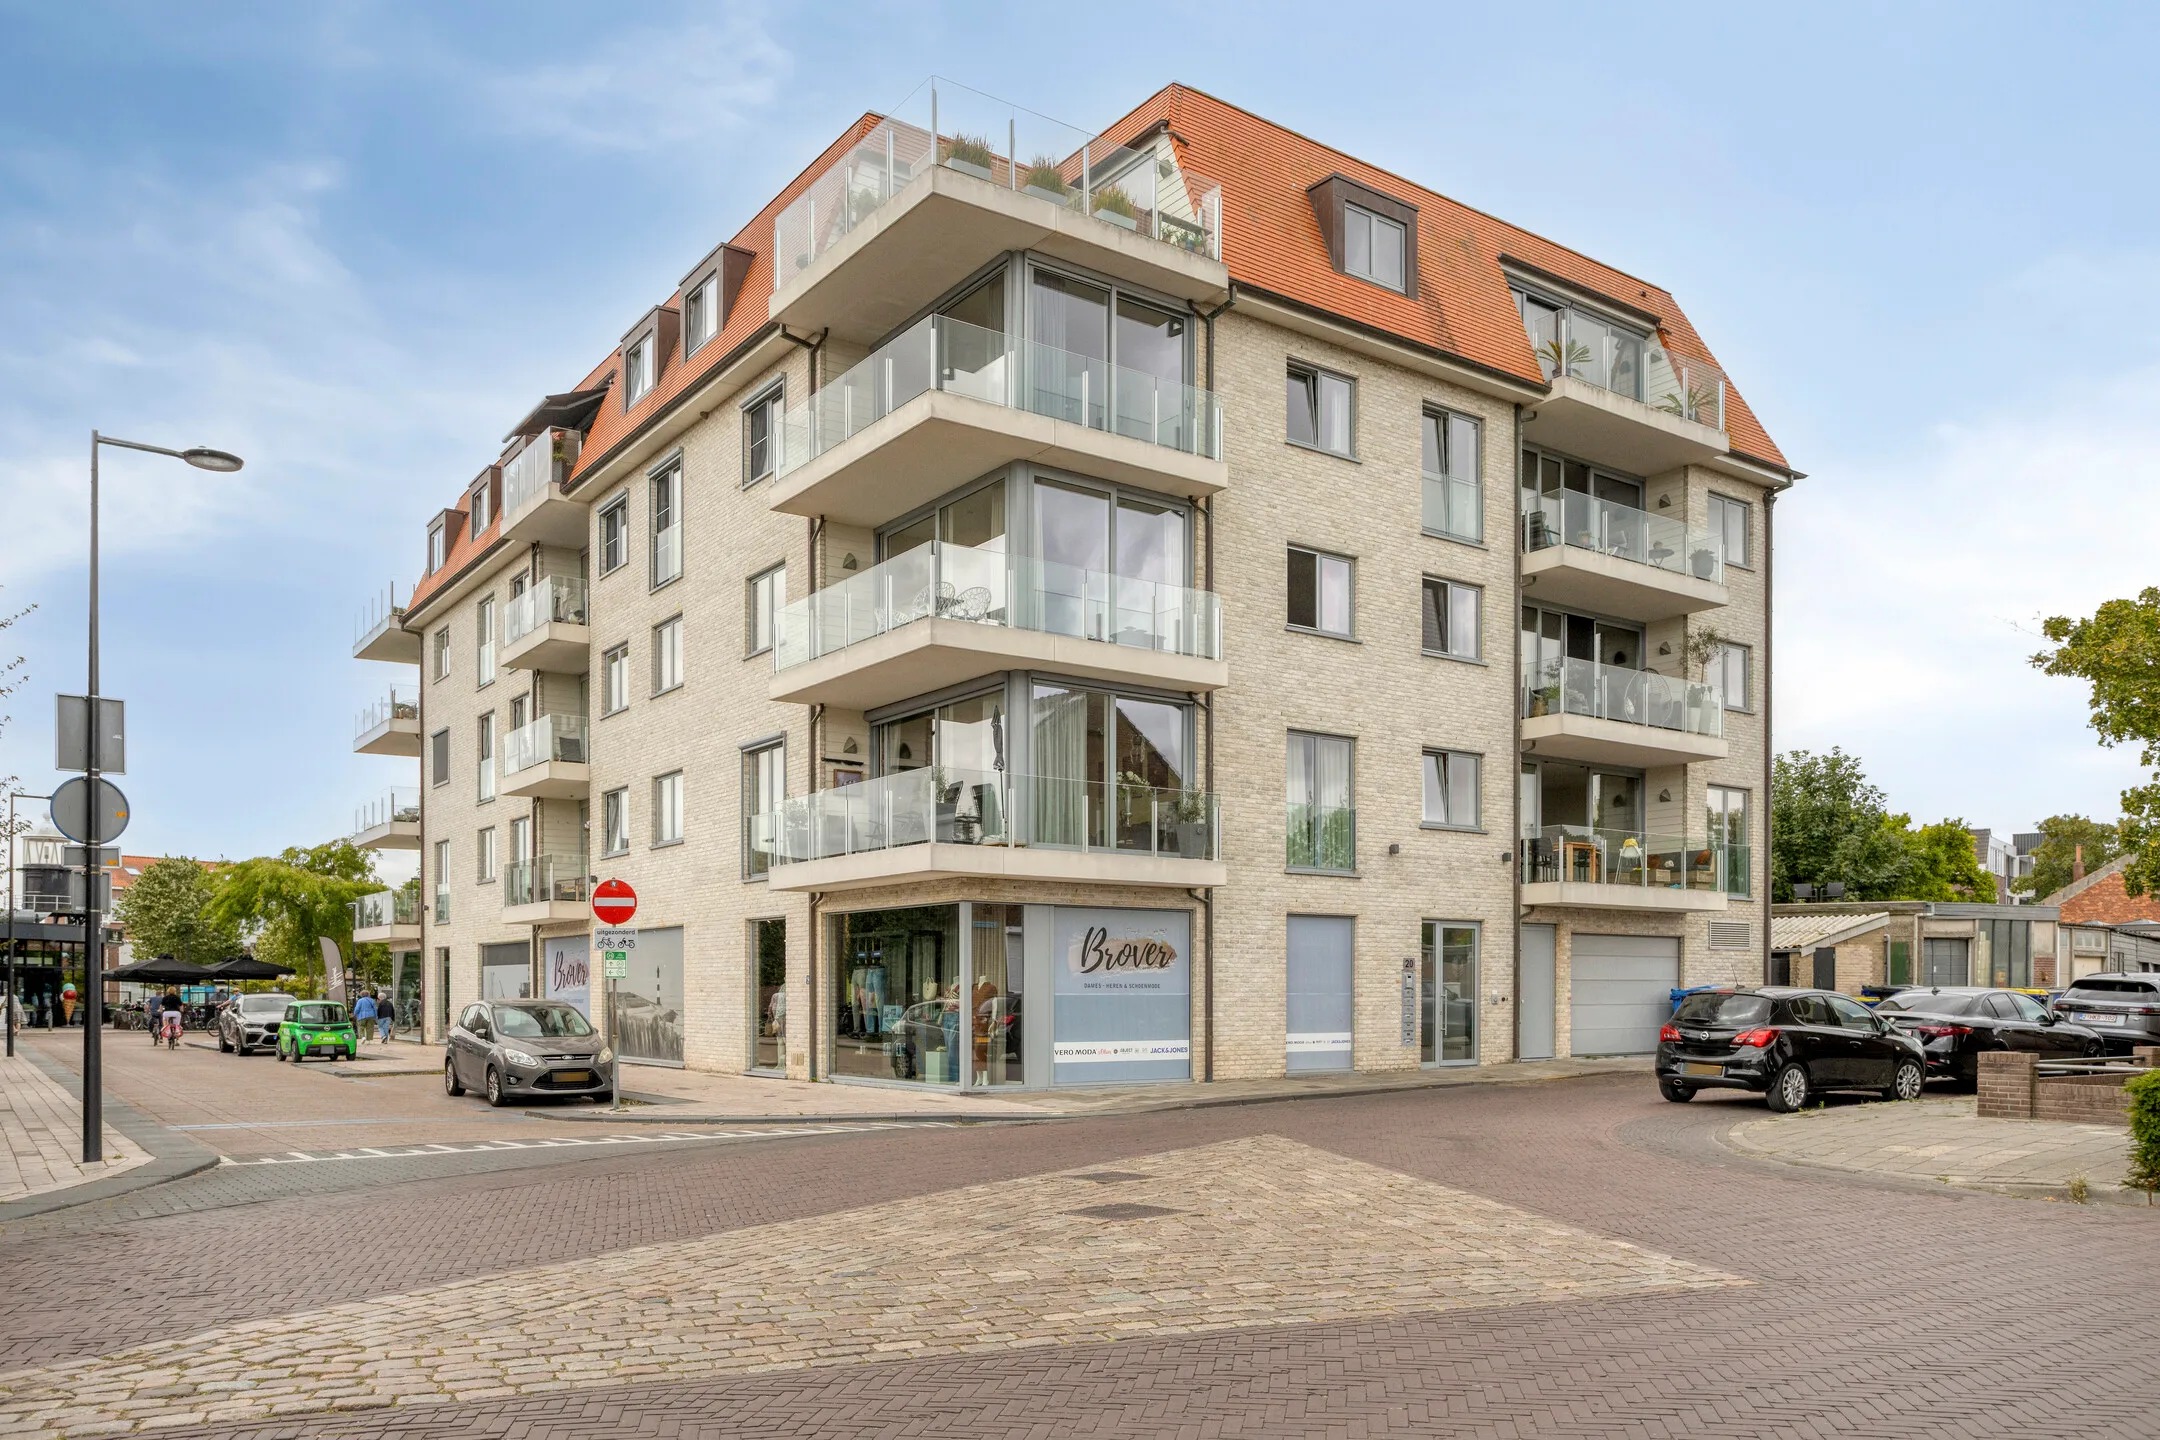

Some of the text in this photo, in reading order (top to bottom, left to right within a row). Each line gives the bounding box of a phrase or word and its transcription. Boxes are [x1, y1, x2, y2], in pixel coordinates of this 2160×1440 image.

[1080, 926, 1173, 974] Brover
[554, 950, 588, 992] Brover
[1405, 959, 1414, 968] 20
[1150, 1046, 1188, 1054] JACK&JONES
